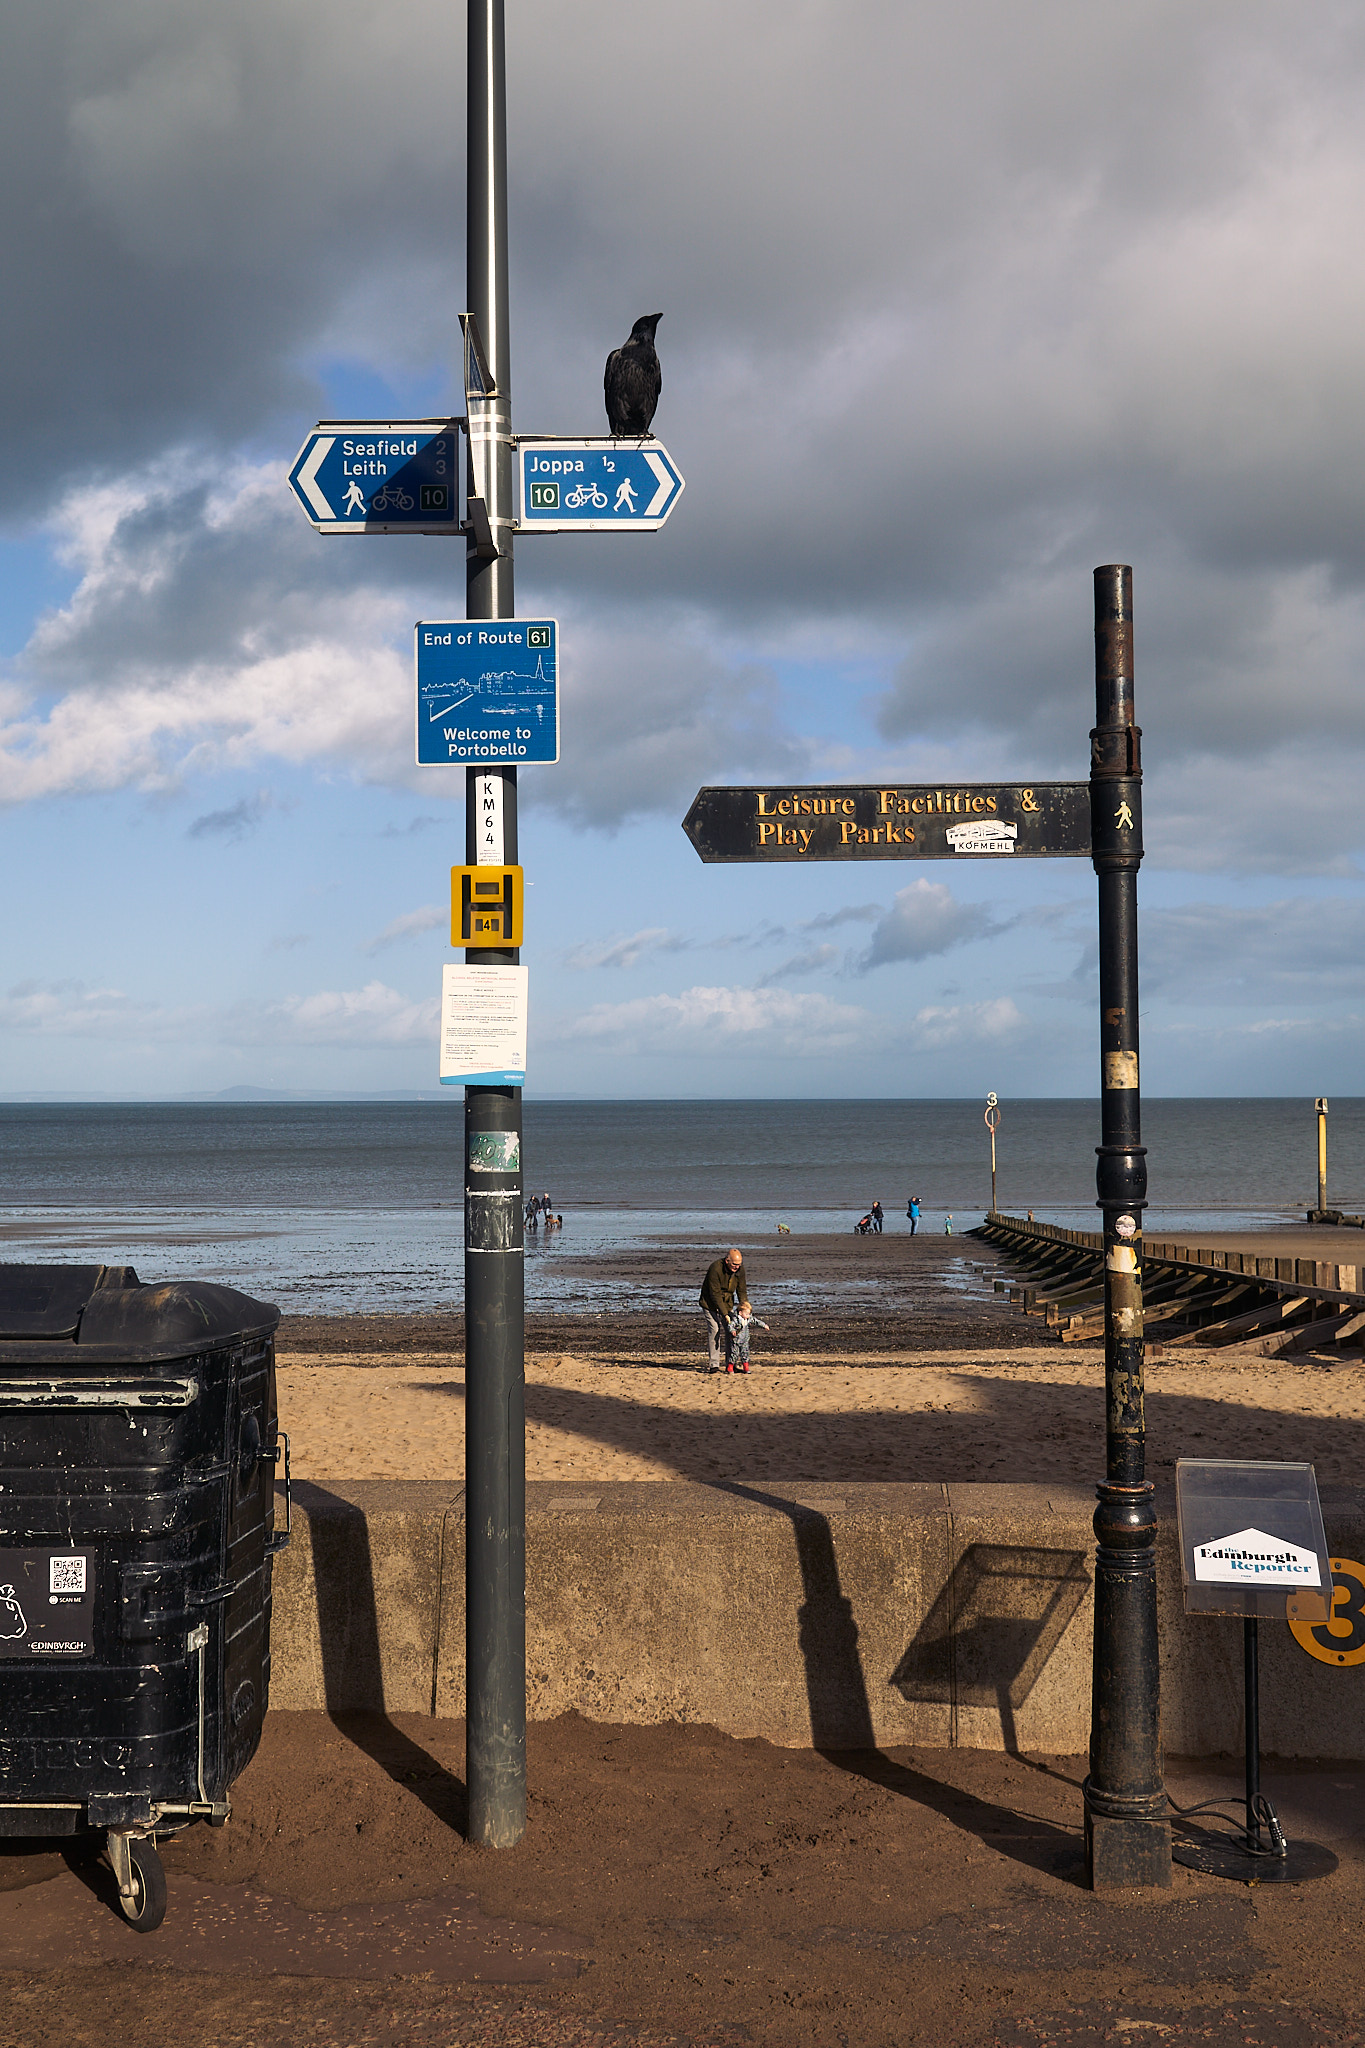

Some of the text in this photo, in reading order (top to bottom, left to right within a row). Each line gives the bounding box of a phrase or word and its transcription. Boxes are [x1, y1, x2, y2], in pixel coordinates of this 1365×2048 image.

[343, 440, 446, 456] Seafield 2
[343, 460, 446, 476] Leith 3
[530, 457, 584, 474] Joppa
[424, 490, 445, 506] 10
[534, 487, 555, 504] 10
[424, 631, 546, 646] End of Route 61
[443, 727, 532, 741] Welcome to
[448, 743, 527, 757] Portobello
[755, 788, 1040, 817] Leisure Facilities &
[757, 820, 916, 852] Play Parks
[483, 920, 491, 931] 4
[987, 1091, 998, 1106] 3
[1200, 1548, 1298, 1564] Edinburgh
[1231, 1560, 1312, 1573] Reporter
[1310, 1572, 1365, 1652] 3
